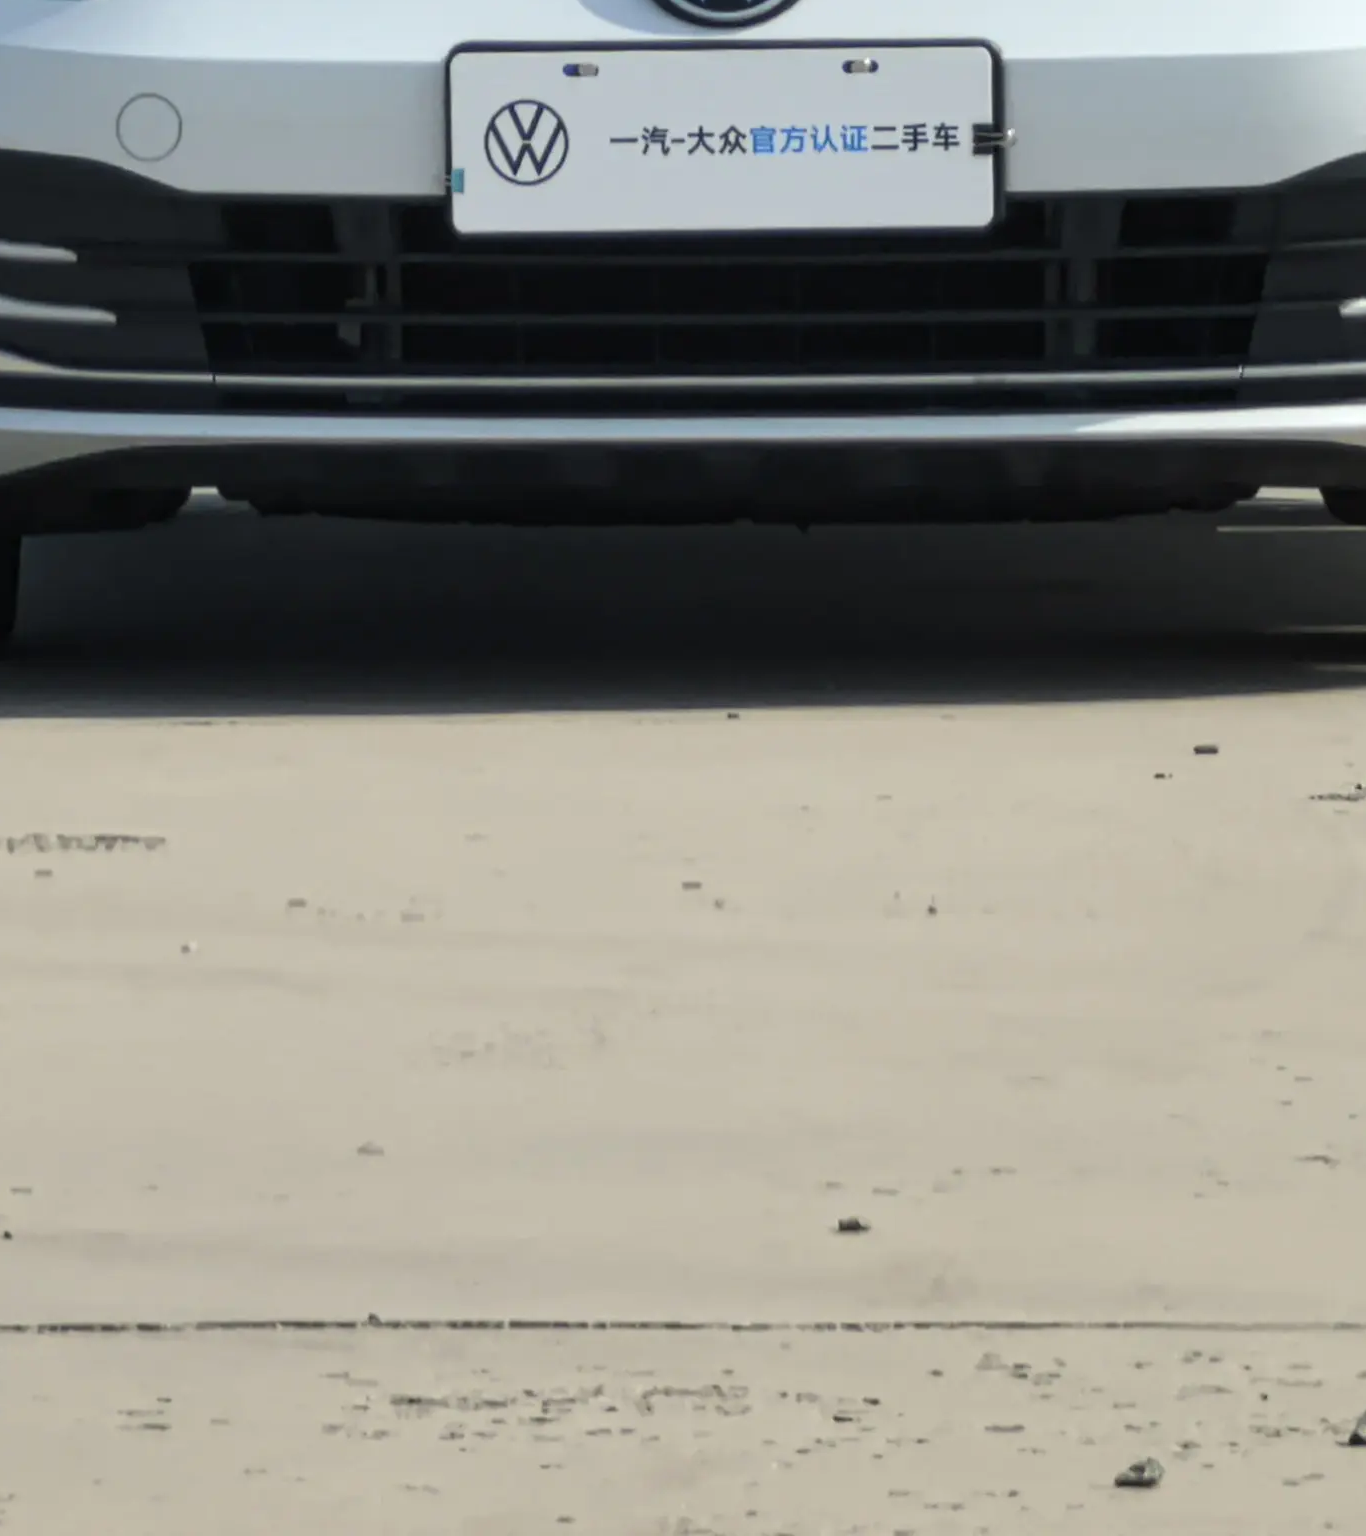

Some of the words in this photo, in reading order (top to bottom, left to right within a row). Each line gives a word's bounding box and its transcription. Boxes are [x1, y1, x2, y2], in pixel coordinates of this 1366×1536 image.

[609, 122, 961, 156] 一汽-大众官方认证二手车
